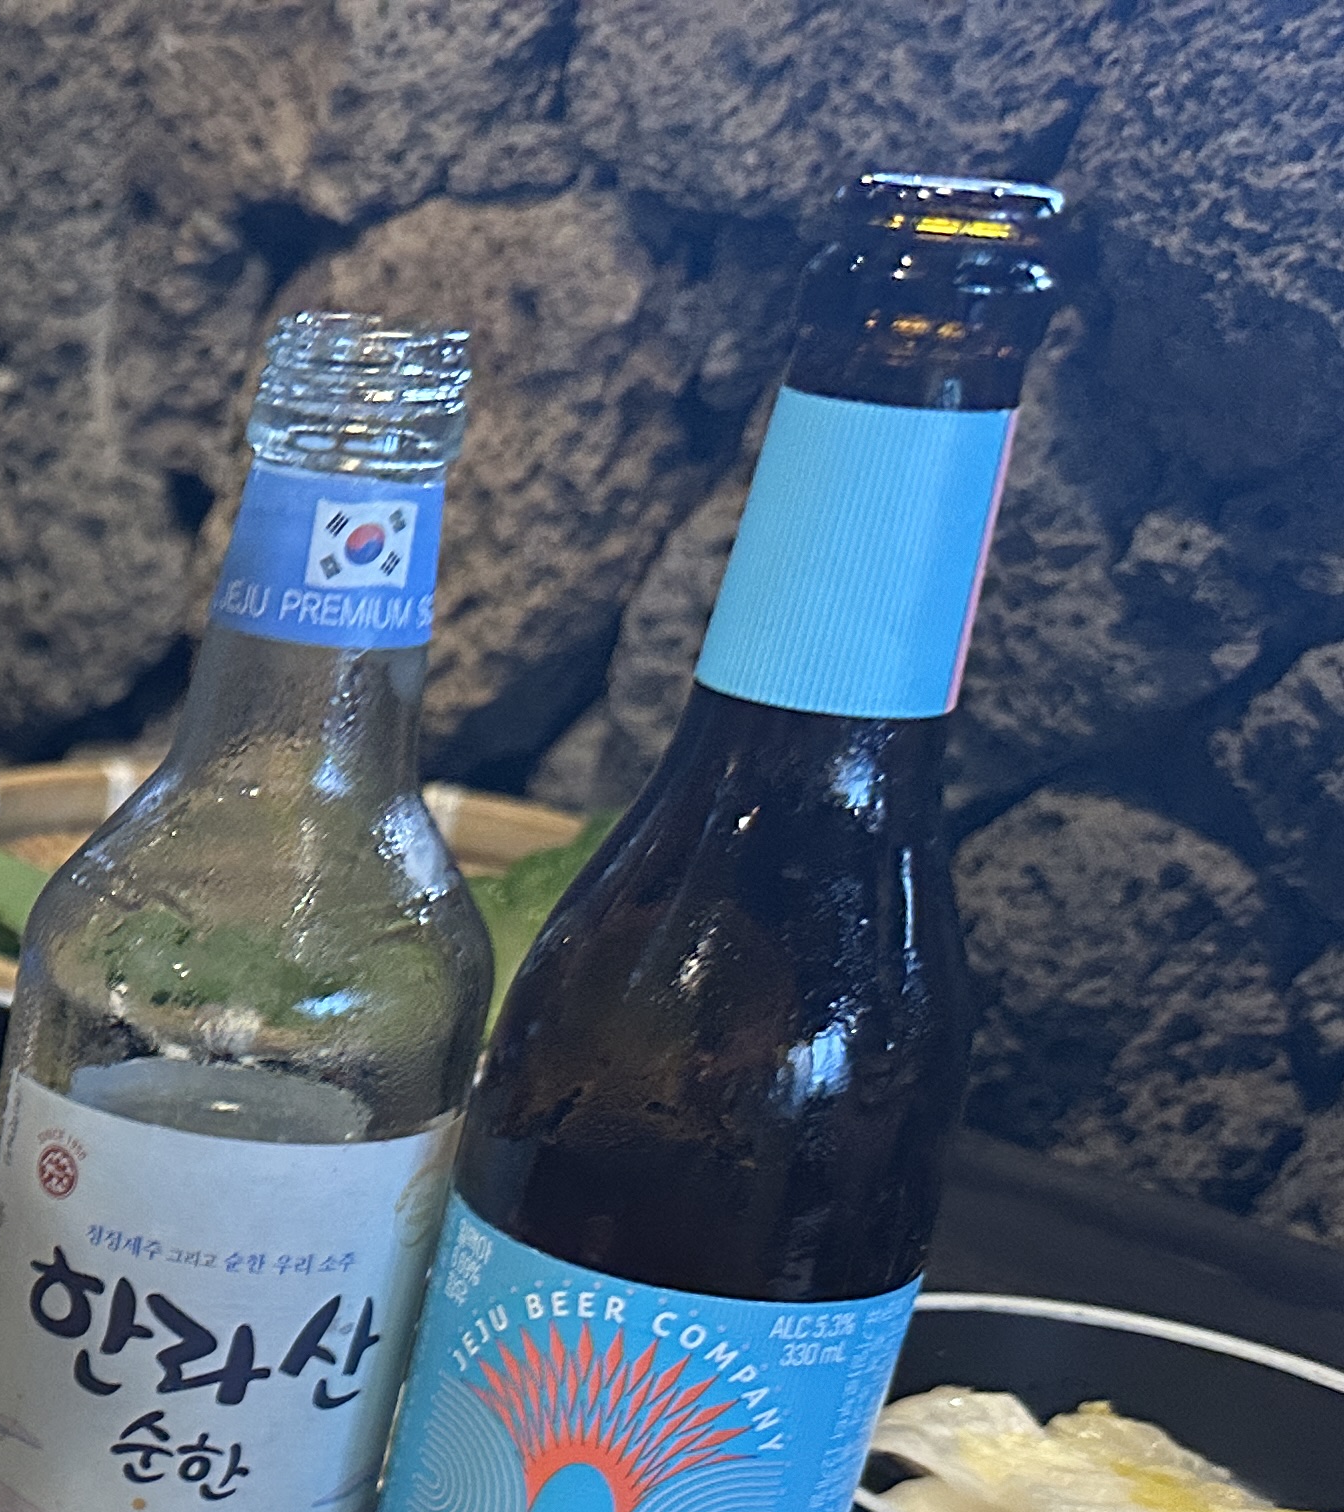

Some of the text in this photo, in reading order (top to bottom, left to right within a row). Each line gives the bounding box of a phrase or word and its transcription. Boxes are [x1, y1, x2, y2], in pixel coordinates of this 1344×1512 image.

[278, 587, 414, 630] PREMIUM
[165, 1248, 216, 1268] 그리고
[223, 1252, 266, 1274] 순한
[273, 1253, 314, 1275] 우리
[317, 1251, 357, 1273] 소주
[30, 1245, 381, 1410] 한라산
[769, 1312, 857, 1340] ALC 5.3%
[452, 1304, 509, 1371] JEJU
[524, 1290, 627, 1325] BEER
[651, 1311, 786, 1451] COMPANY
[110, 1410, 250, 1501] 순한
